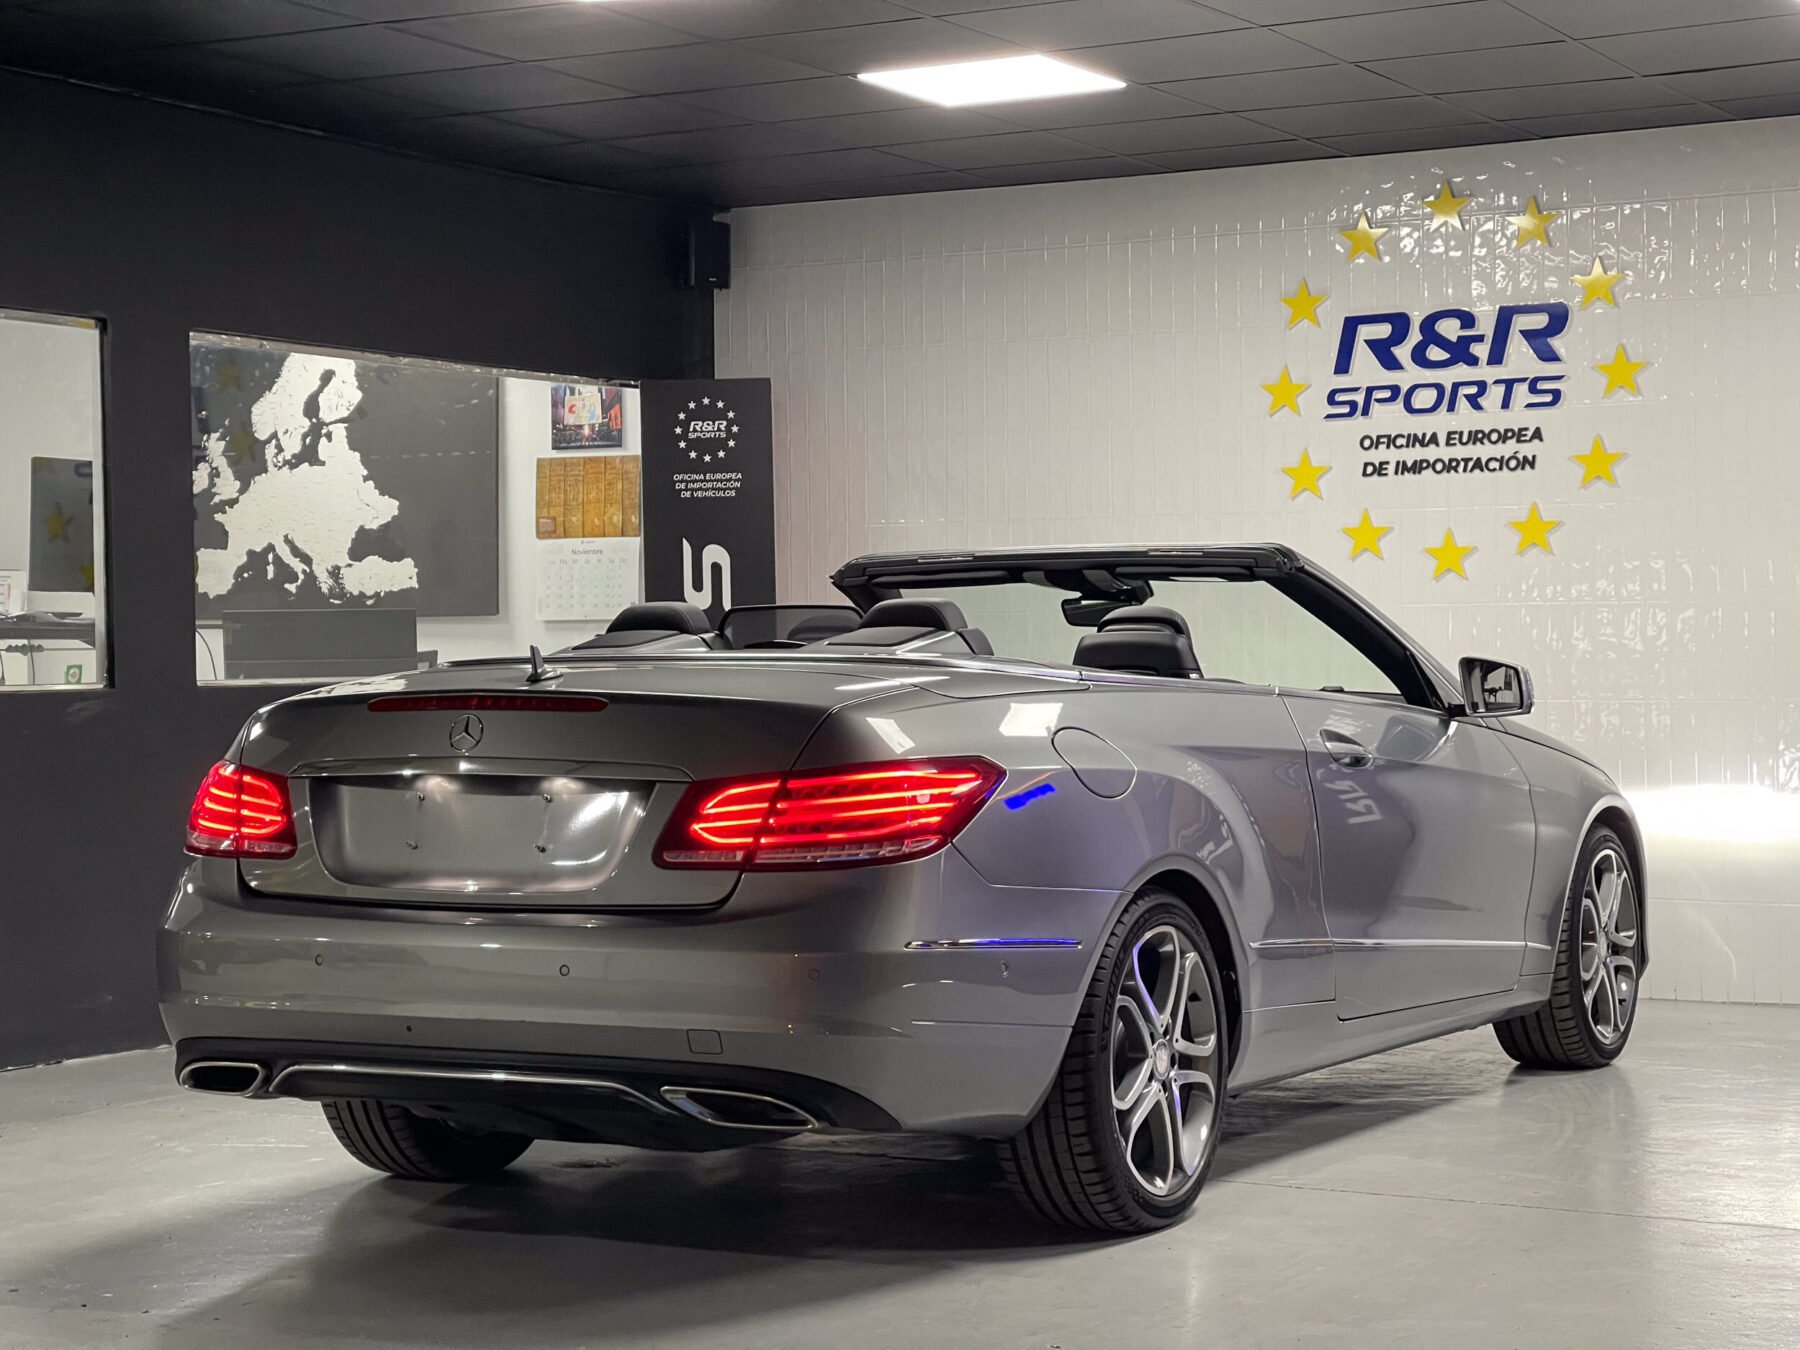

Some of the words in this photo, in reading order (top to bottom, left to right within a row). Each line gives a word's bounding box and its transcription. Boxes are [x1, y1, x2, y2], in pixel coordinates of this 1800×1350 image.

[1333, 301, 1570, 375] R&R
[1323, 374, 1567, 420] SPORTS
[689, 420, 727, 432] R&R
[1359, 431, 1440, 452] OFICINA
[1445, 426, 1544, 448] EUROPEA
[1361, 460, 1390, 478] DE
[1394, 451, 1537, 476] IMPORTACIÓN
[673, 473, 704, 481] OFICINA
[705, 472, 742, 480] EUROPEA
[687, 480, 741, 489] IMPORTACIÓN
[693, 489, 736, 497] VEHÍCULOS
